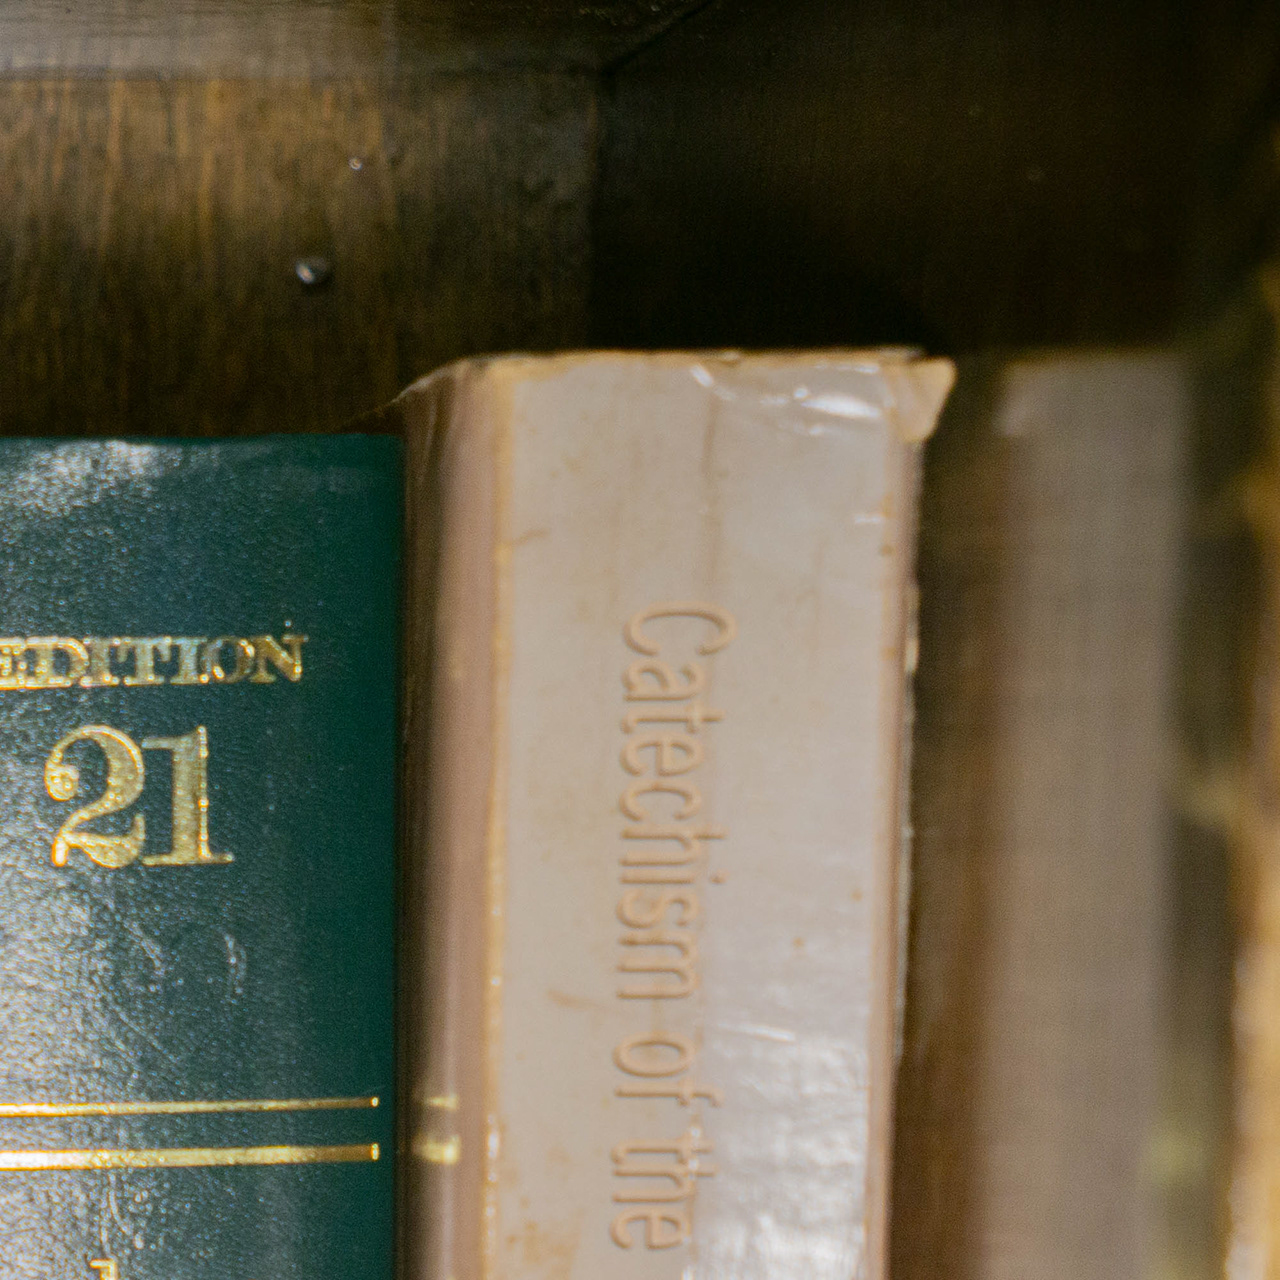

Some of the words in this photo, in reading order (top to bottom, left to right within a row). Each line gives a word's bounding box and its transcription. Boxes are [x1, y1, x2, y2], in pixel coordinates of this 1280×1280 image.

[44, 724, 234, 869] 21
[617, 605, 736, 1002] Catechism
[612, 1030, 721, 1108] of
[609, 1138, 716, 1253] the
